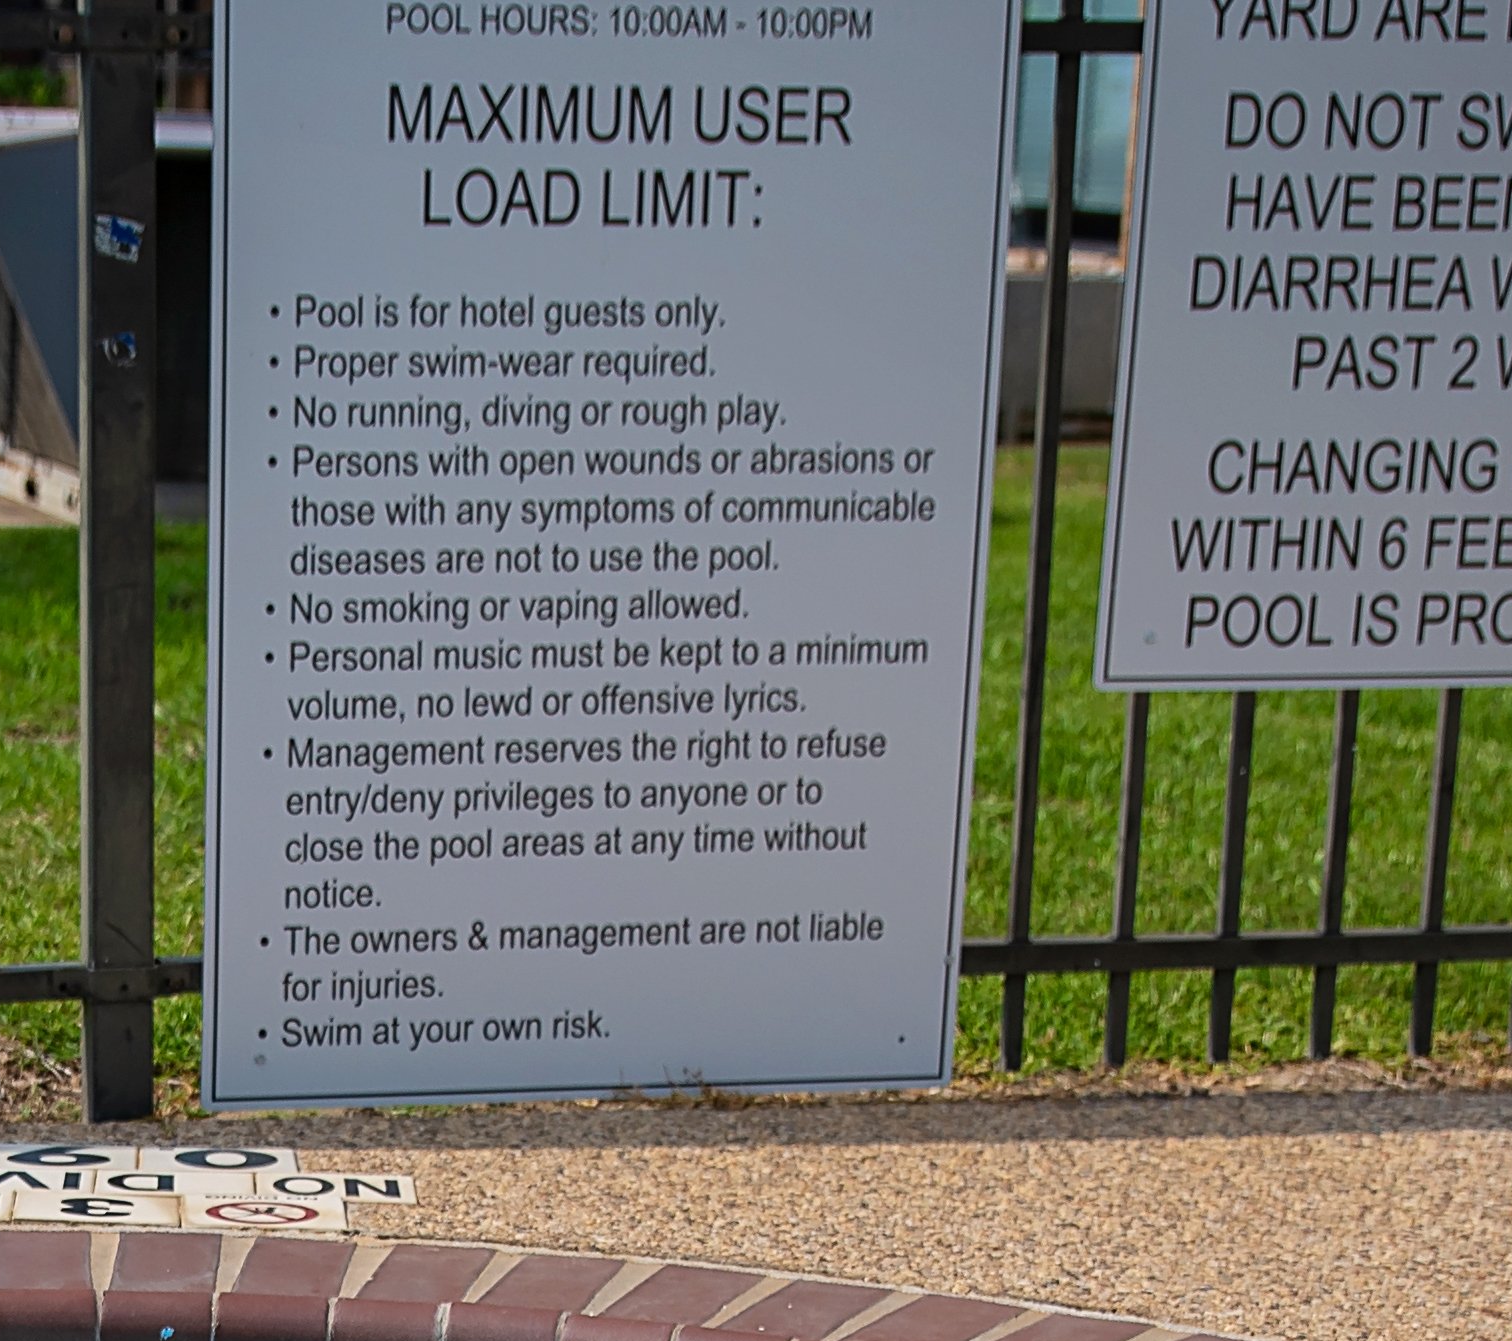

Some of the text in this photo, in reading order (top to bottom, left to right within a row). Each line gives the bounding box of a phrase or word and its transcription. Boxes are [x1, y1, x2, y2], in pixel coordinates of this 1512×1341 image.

[386, 2, 470, 34] POOL
[480, 3, 598, 36] HOURS:
[609, 4, 727, 37] 10:00AM
[756, 6, 872, 39] 10:00PM
[1211, 0, 1359, 40] YARD
[1373, 0, 1487, 42] ARE
[387, 82, 851, 145] MAXIMUM USER
[1224, 91, 1307, 150] DO
[1324, 91, 1444, 151] NOT
[422, 167, 762, 227] LOAD LIMIT:
[1225, 173, 1376, 231] HAVE
[1189, 254, 1472, 311] DIARRHEA
[295, 293, 725, 335] Pool is for hotel guests only.
[294, 343, 714, 386] Proper swim-wear required.
[1292, 333, 1437, 390] PAST
[1448, 334, 1479, 389] 2
[1207, 437, 1498, 494] CHANGING
[291, 489, 935, 533] those with any symptoms of communicable
[1171, 516, 1363, 572] WITHIN
[1378, 516, 1407, 571] 6
[1184, 593, 1333, 648] POOL
[1351, 592, 1399, 647] IS
[284, 877, 381, 909] notice.
[281, 1009, 610, 1050] Swim at your own risk.
[59, 1197, 135, 1217] 3
[273, 1175, 401, 1198] NO
